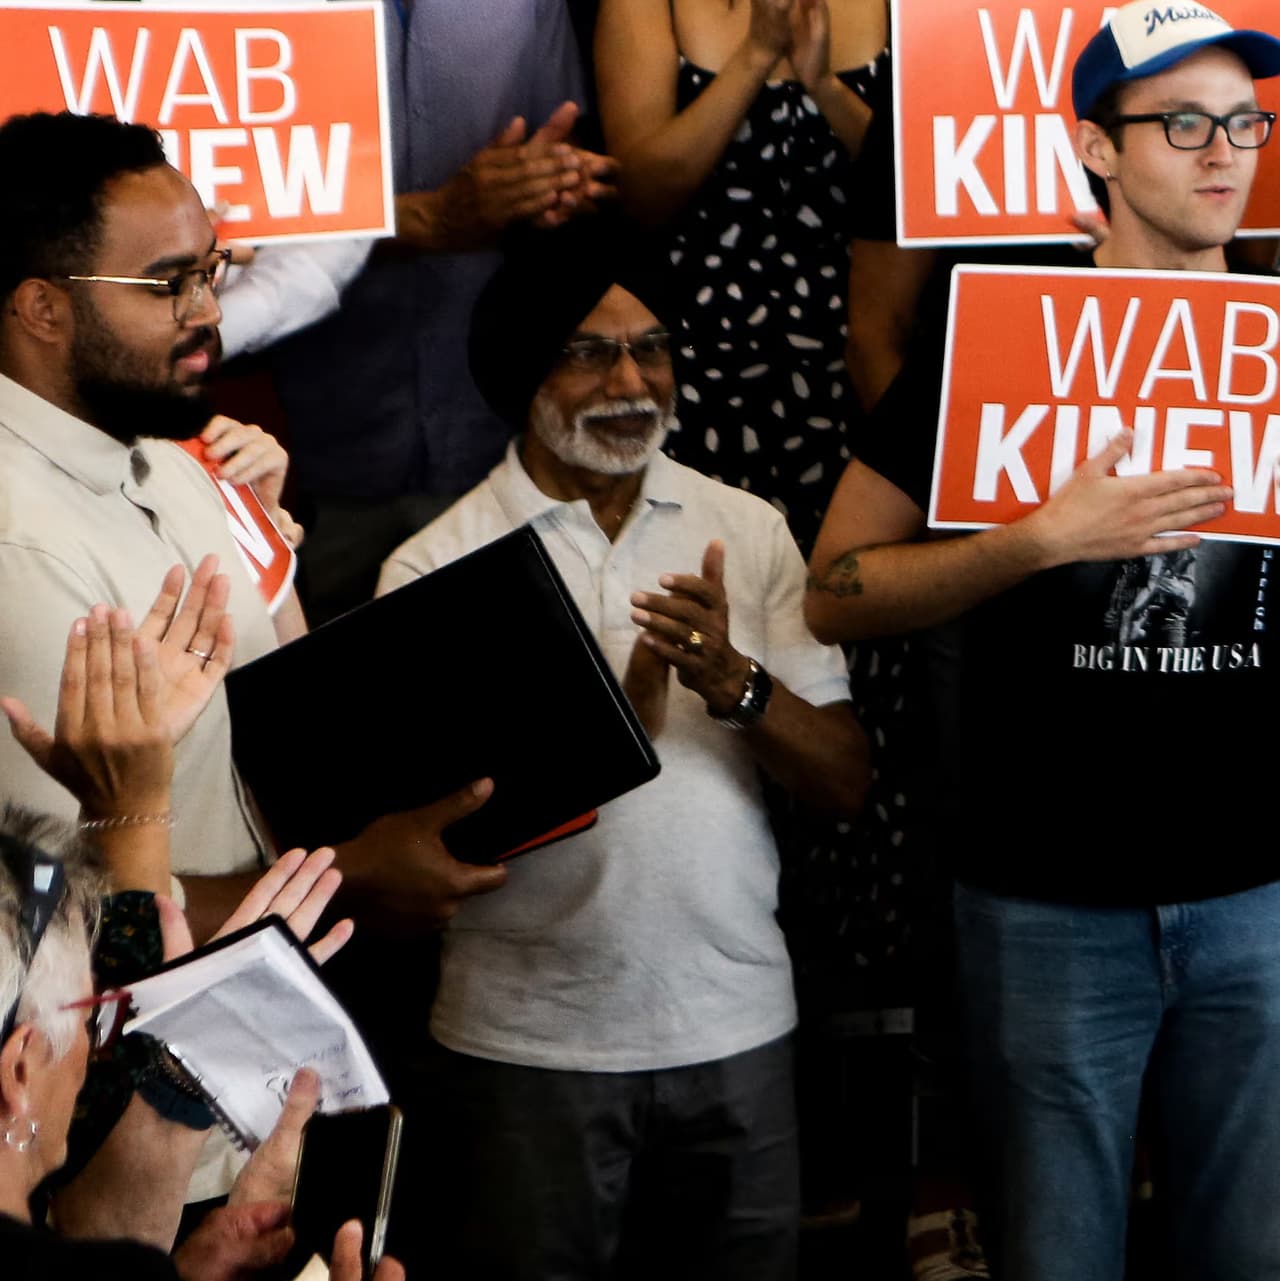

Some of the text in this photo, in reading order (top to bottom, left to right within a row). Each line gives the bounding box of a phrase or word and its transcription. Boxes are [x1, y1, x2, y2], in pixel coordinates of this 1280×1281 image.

[48, 25, 298, 124] WAB
[932, 113, 1100, 217] KIN
[1073, 642, 1262, 673] BIG IN THE USA
